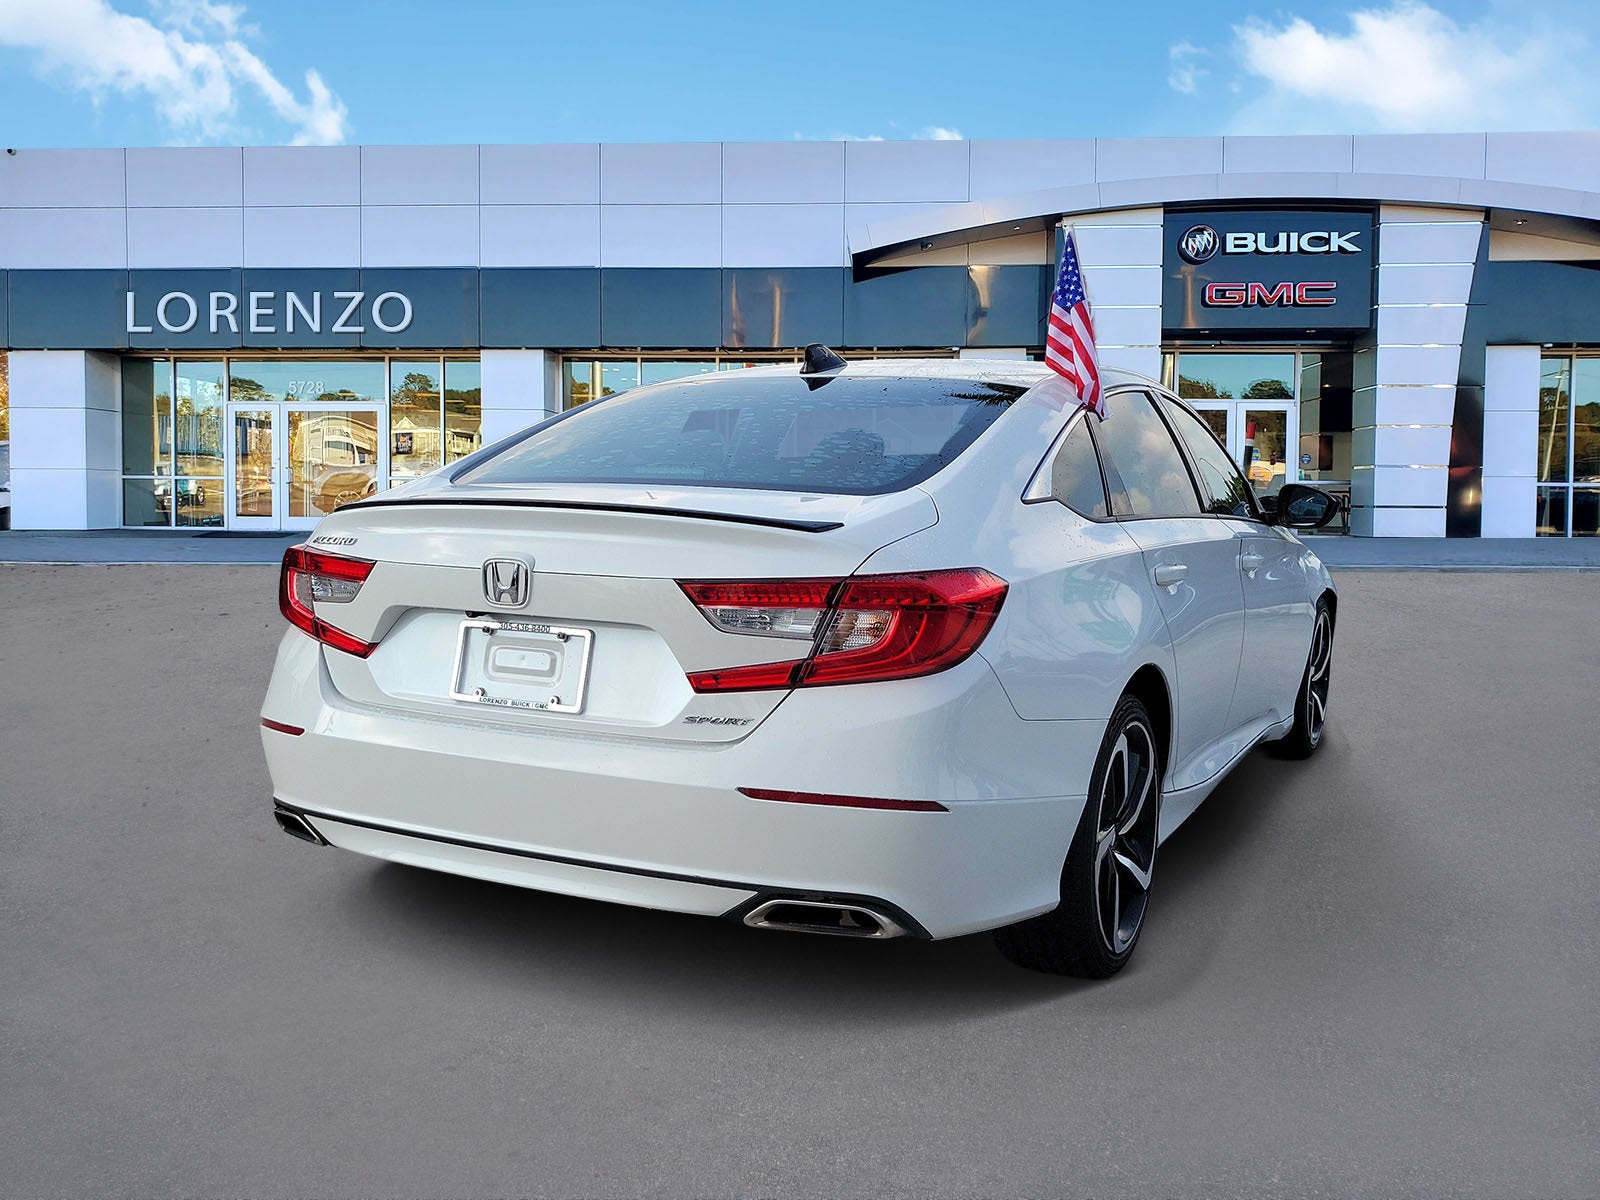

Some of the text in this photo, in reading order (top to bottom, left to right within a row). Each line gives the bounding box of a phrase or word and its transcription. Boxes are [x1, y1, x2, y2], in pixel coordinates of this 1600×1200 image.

[1226, 231, 1362, 252] BUICK
[1205, 281, 1337, 304] GMC
[126, 290, 414, 334] LORENZO
[288, 380, 325, 394] 5728
[312, 535, 358, 546] ACCORD
[479, 697, 549, 710] LORENZO BUICK GMC
[682, 715, 755, 726] SPORT
